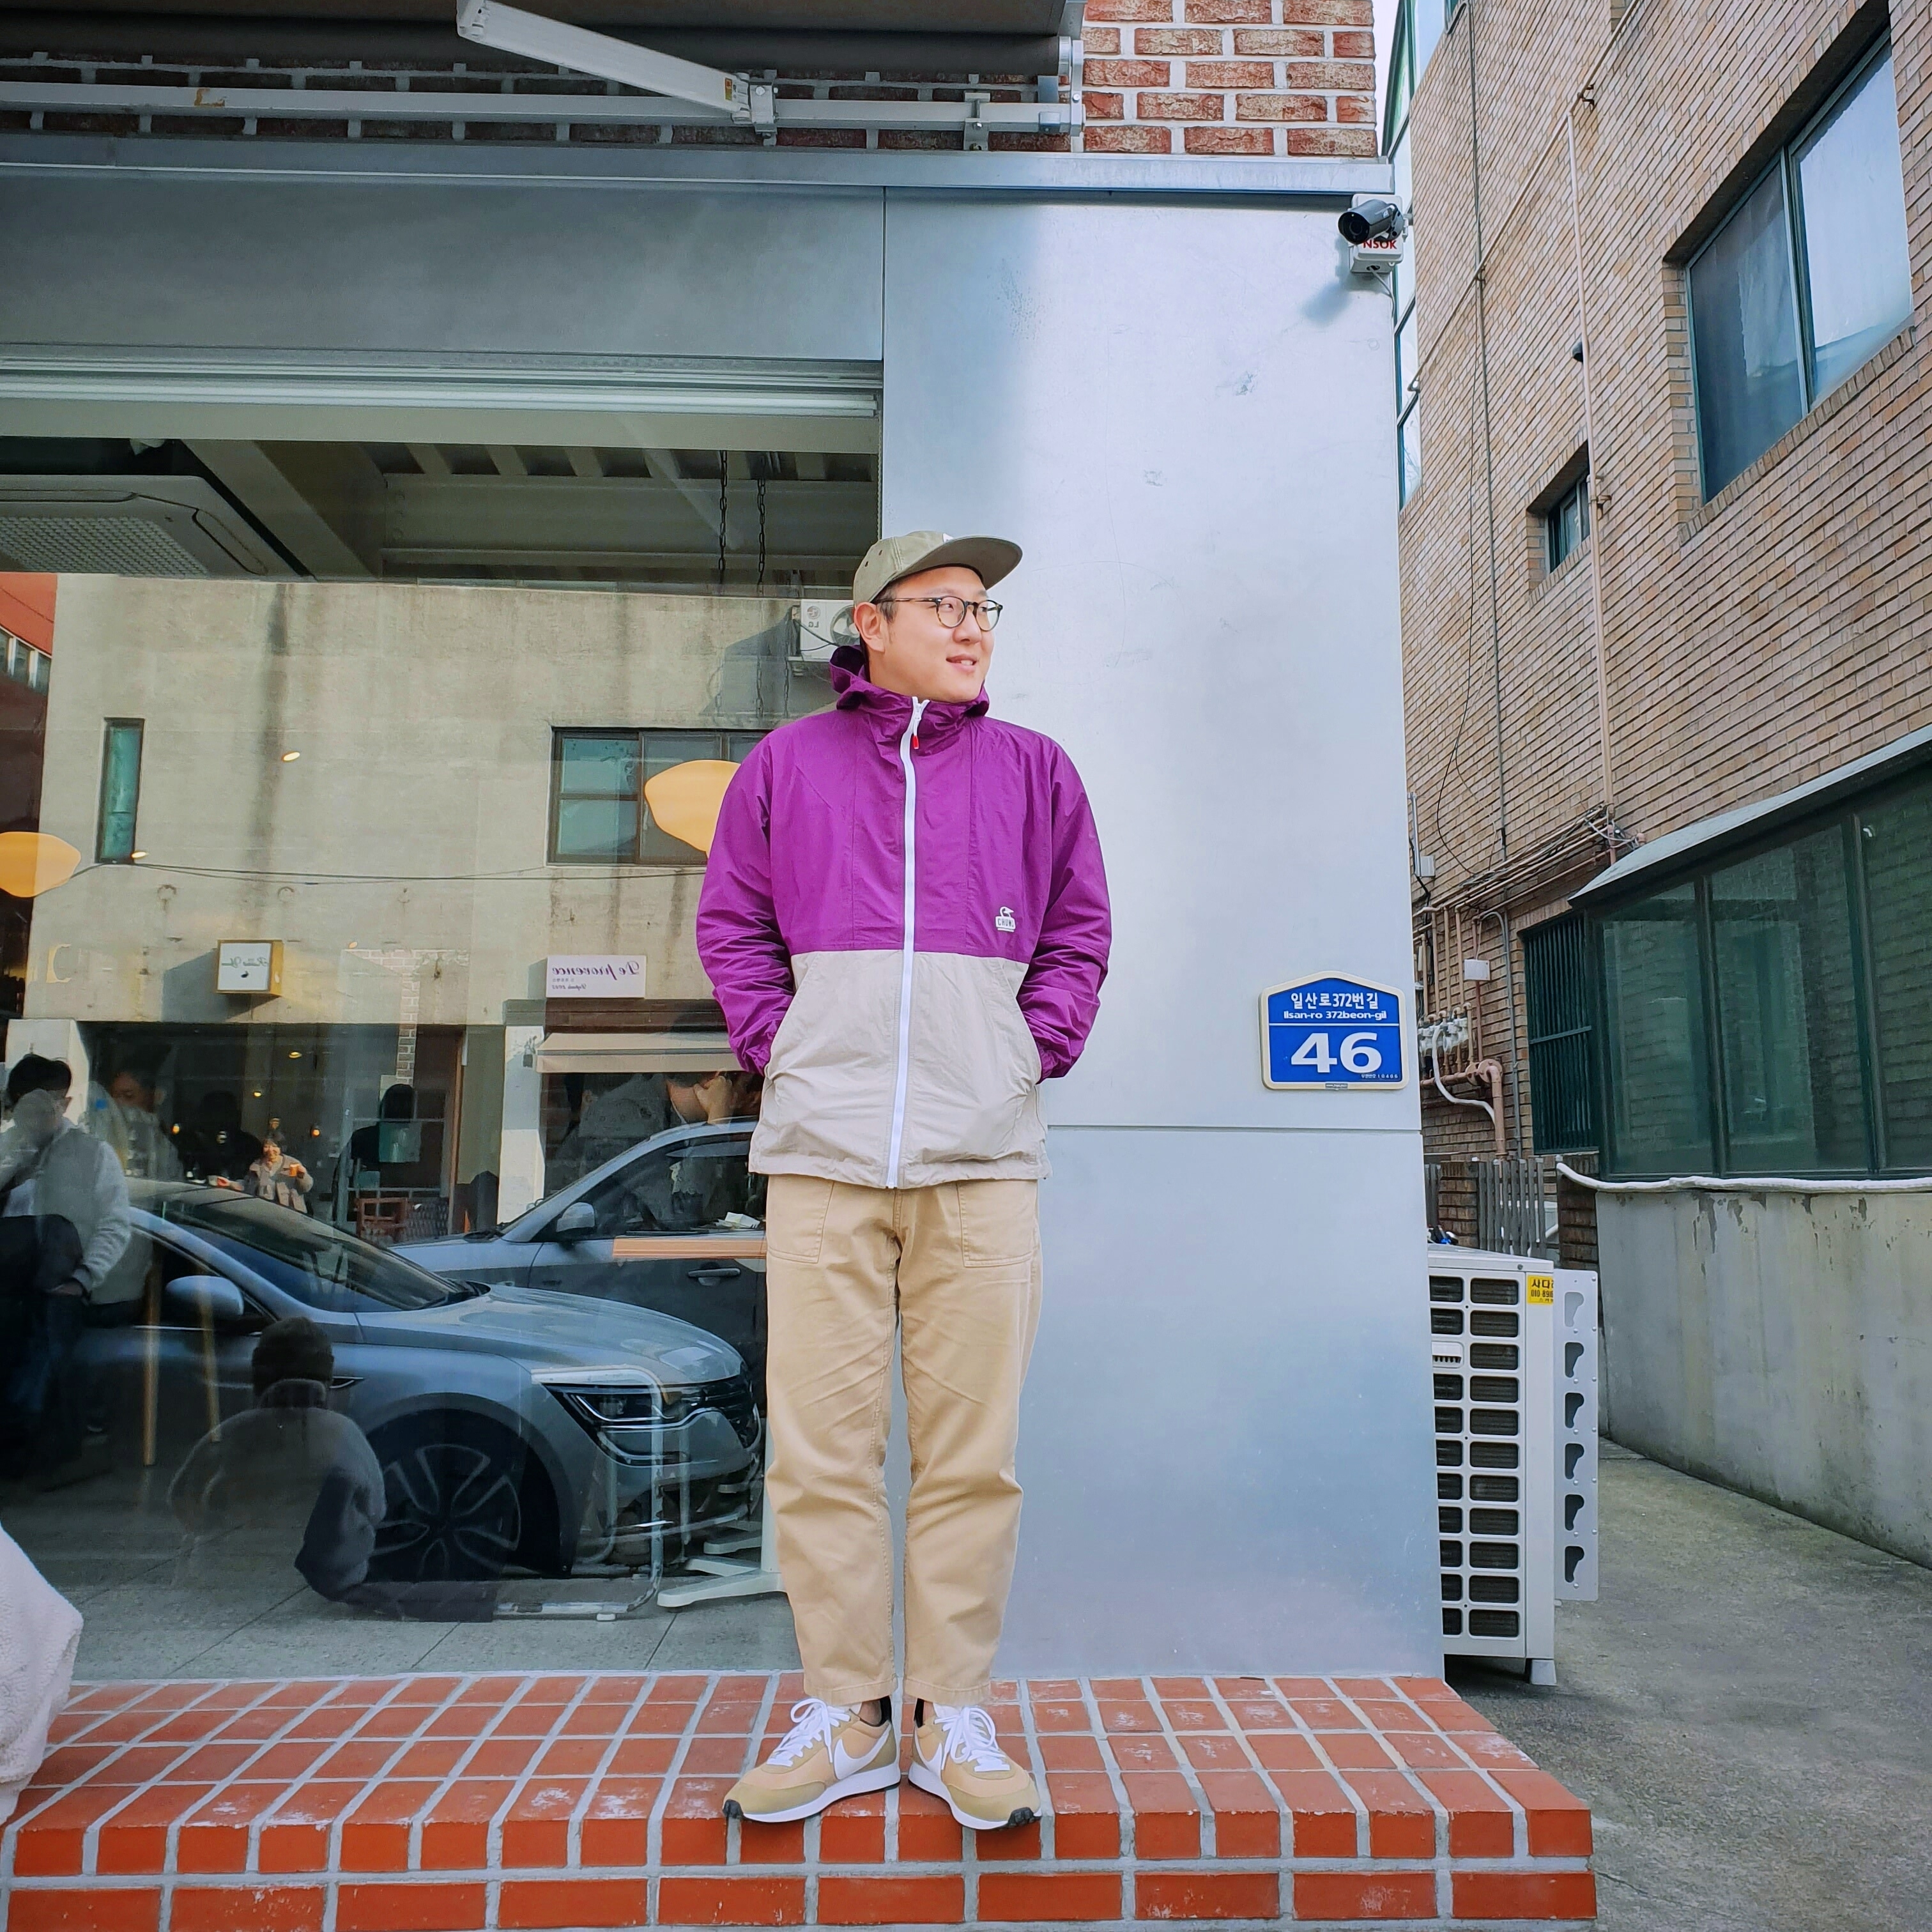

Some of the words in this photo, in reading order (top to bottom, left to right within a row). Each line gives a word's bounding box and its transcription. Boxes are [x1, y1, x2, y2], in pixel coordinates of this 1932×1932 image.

[1363, 240, 1397, 249] NSOK
[1291, 992, 1378, 1009] 일산로372번길
[1284, 1011, 1322, 1019] Ilsan-ro
[1326, 1011, 1386, 1020] 372beon-gil
[1291, 1032, 1382, 1073] 46
